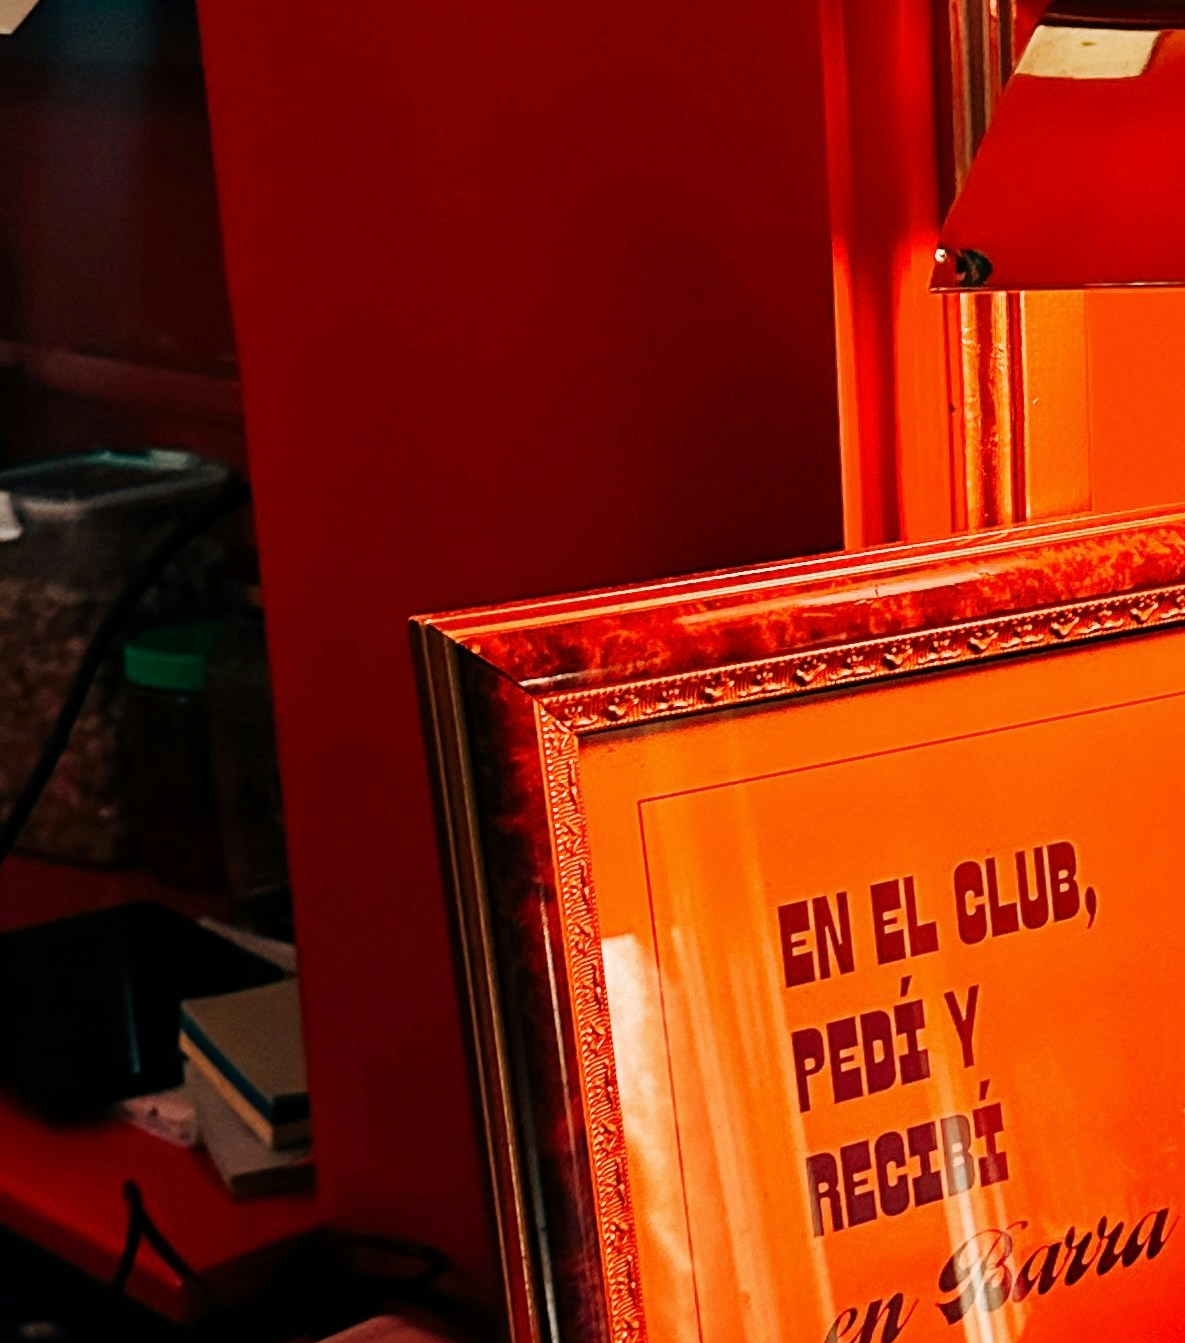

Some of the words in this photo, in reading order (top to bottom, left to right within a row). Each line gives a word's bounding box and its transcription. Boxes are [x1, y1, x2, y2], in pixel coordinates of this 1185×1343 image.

[777, 890, 855, 988] EN
[870, 875, 939, 966] EL
[953, 841, 1097, 945] CLUB,
[791, 975, 931, 1113] PEDÍ
[944, 984, 979, 1068] Y
[805, 1079, 1009, 1237] RECIBÍ
[936, 1207, 1181, 1325] Barra
